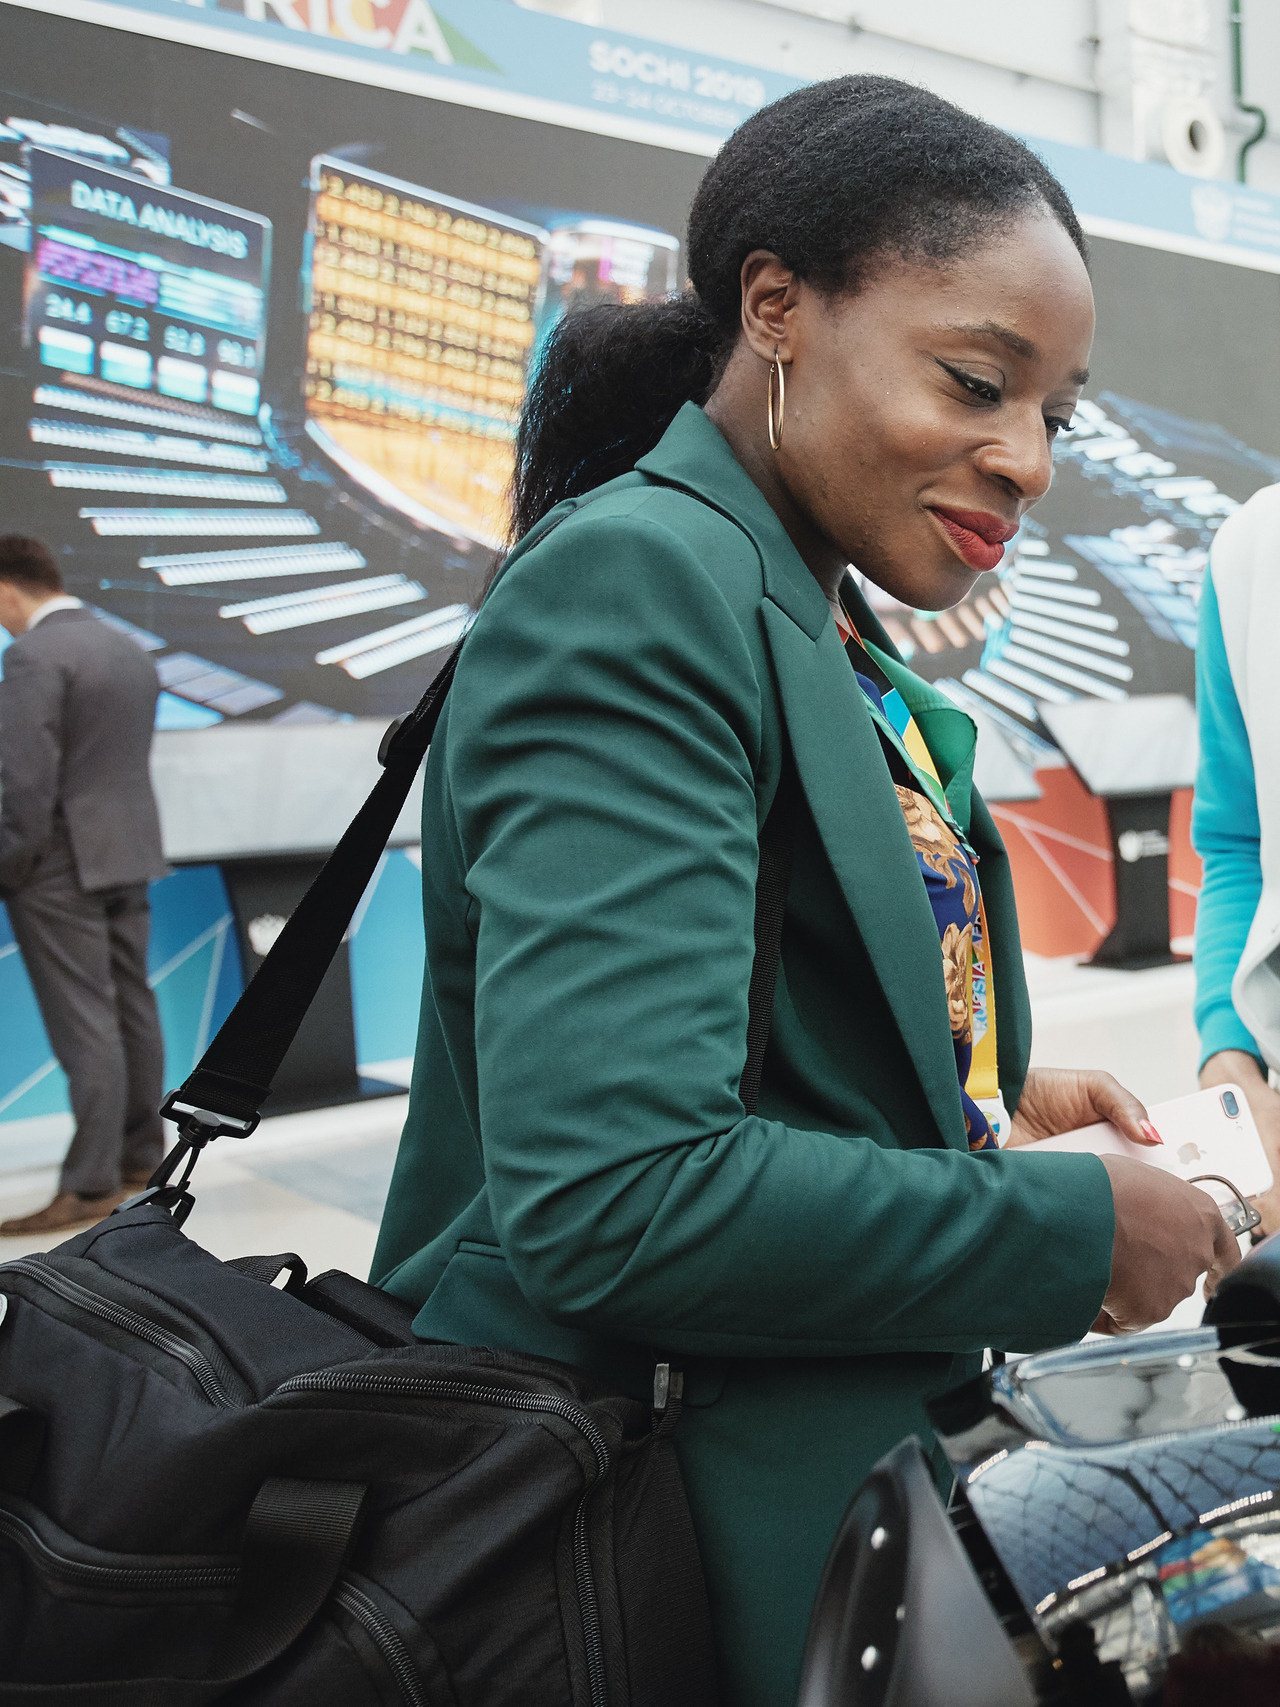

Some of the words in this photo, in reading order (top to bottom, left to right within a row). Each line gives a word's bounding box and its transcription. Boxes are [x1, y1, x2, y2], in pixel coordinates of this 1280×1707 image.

[588, 39, 691, 92] SOCHI
[71, 179, 138, 226] DATA
[138, 202, 248, 260] ANALYSIS
